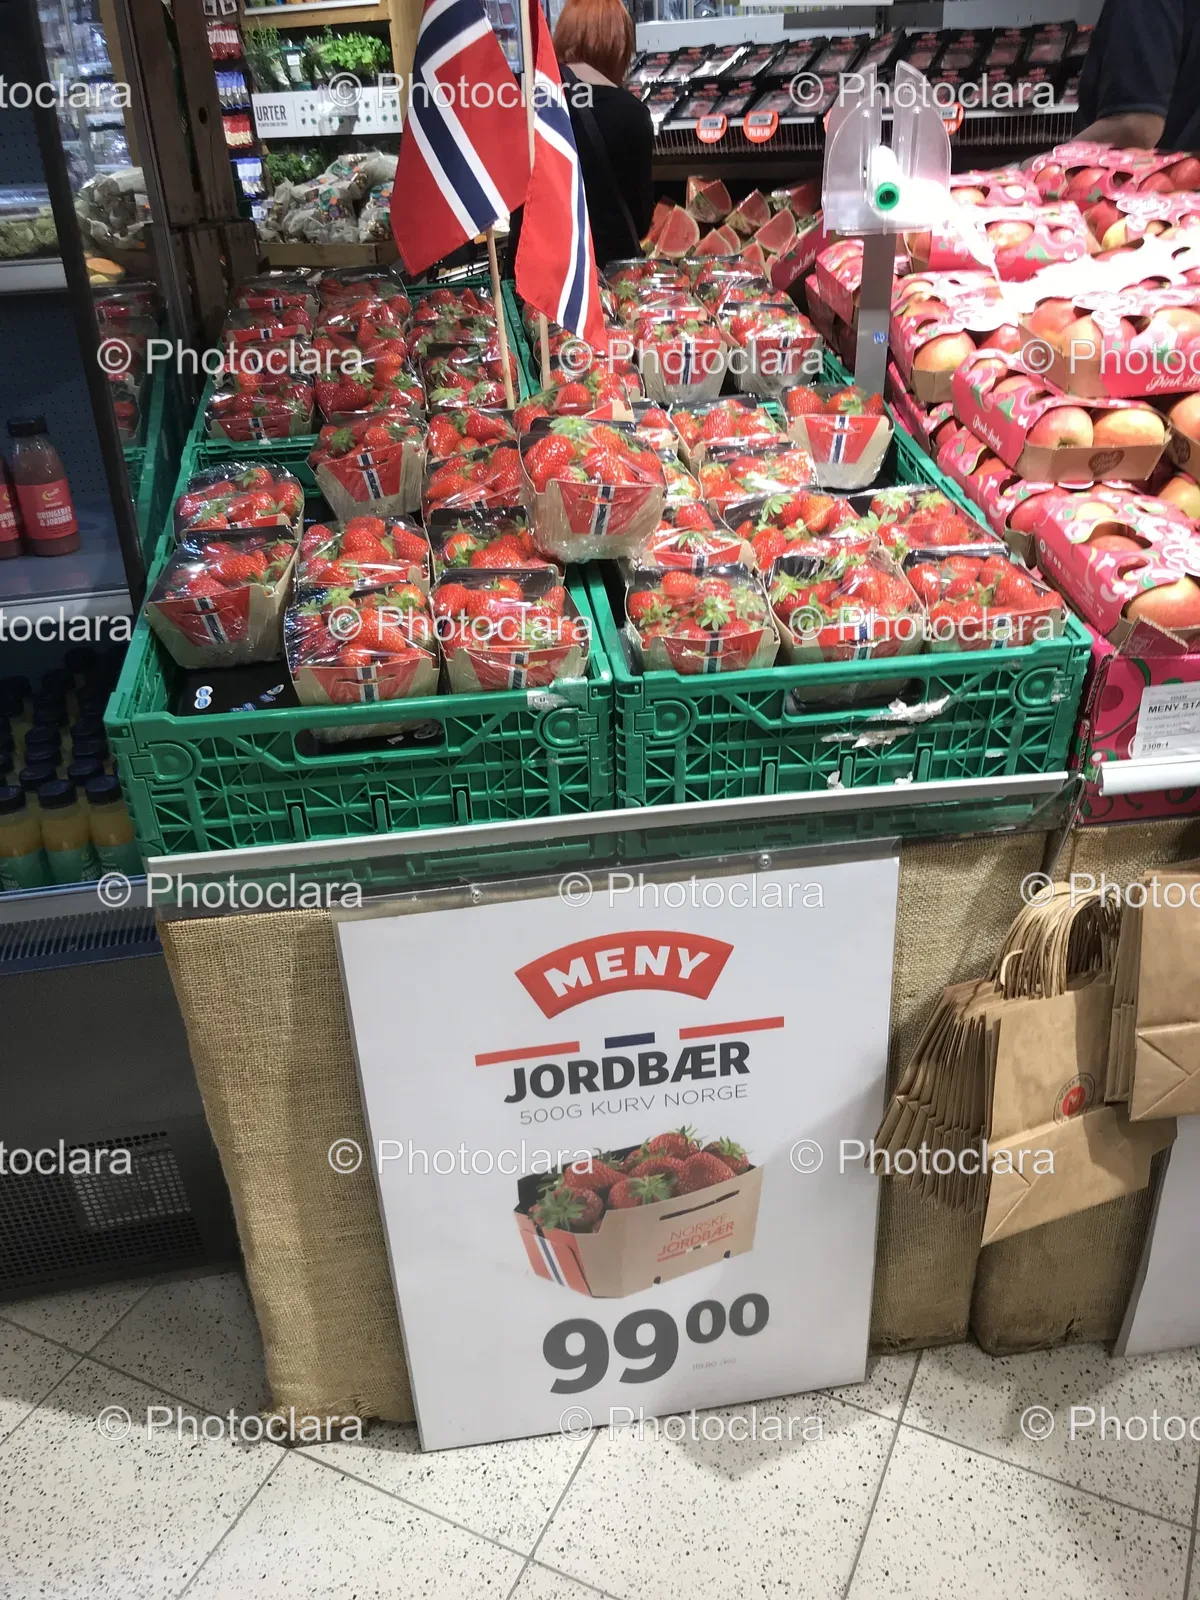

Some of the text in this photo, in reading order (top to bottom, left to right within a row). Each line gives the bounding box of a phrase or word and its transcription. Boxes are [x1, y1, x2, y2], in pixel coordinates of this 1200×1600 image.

[256, 105, 287, 121] URTER
[1145, 372, 1184, 392] Pink
[1148, 703, 1180, 714] MENY
[543, 945, 711, 998] MENY
[504, 1041, 751, 1104] JORDBÆR
[520, 1083, 749, 1125] 500G KURV NORGE
[657, 1221, 735, 1256] JORDBÆR
[670, 1212, 728, 1241] NORSKE
